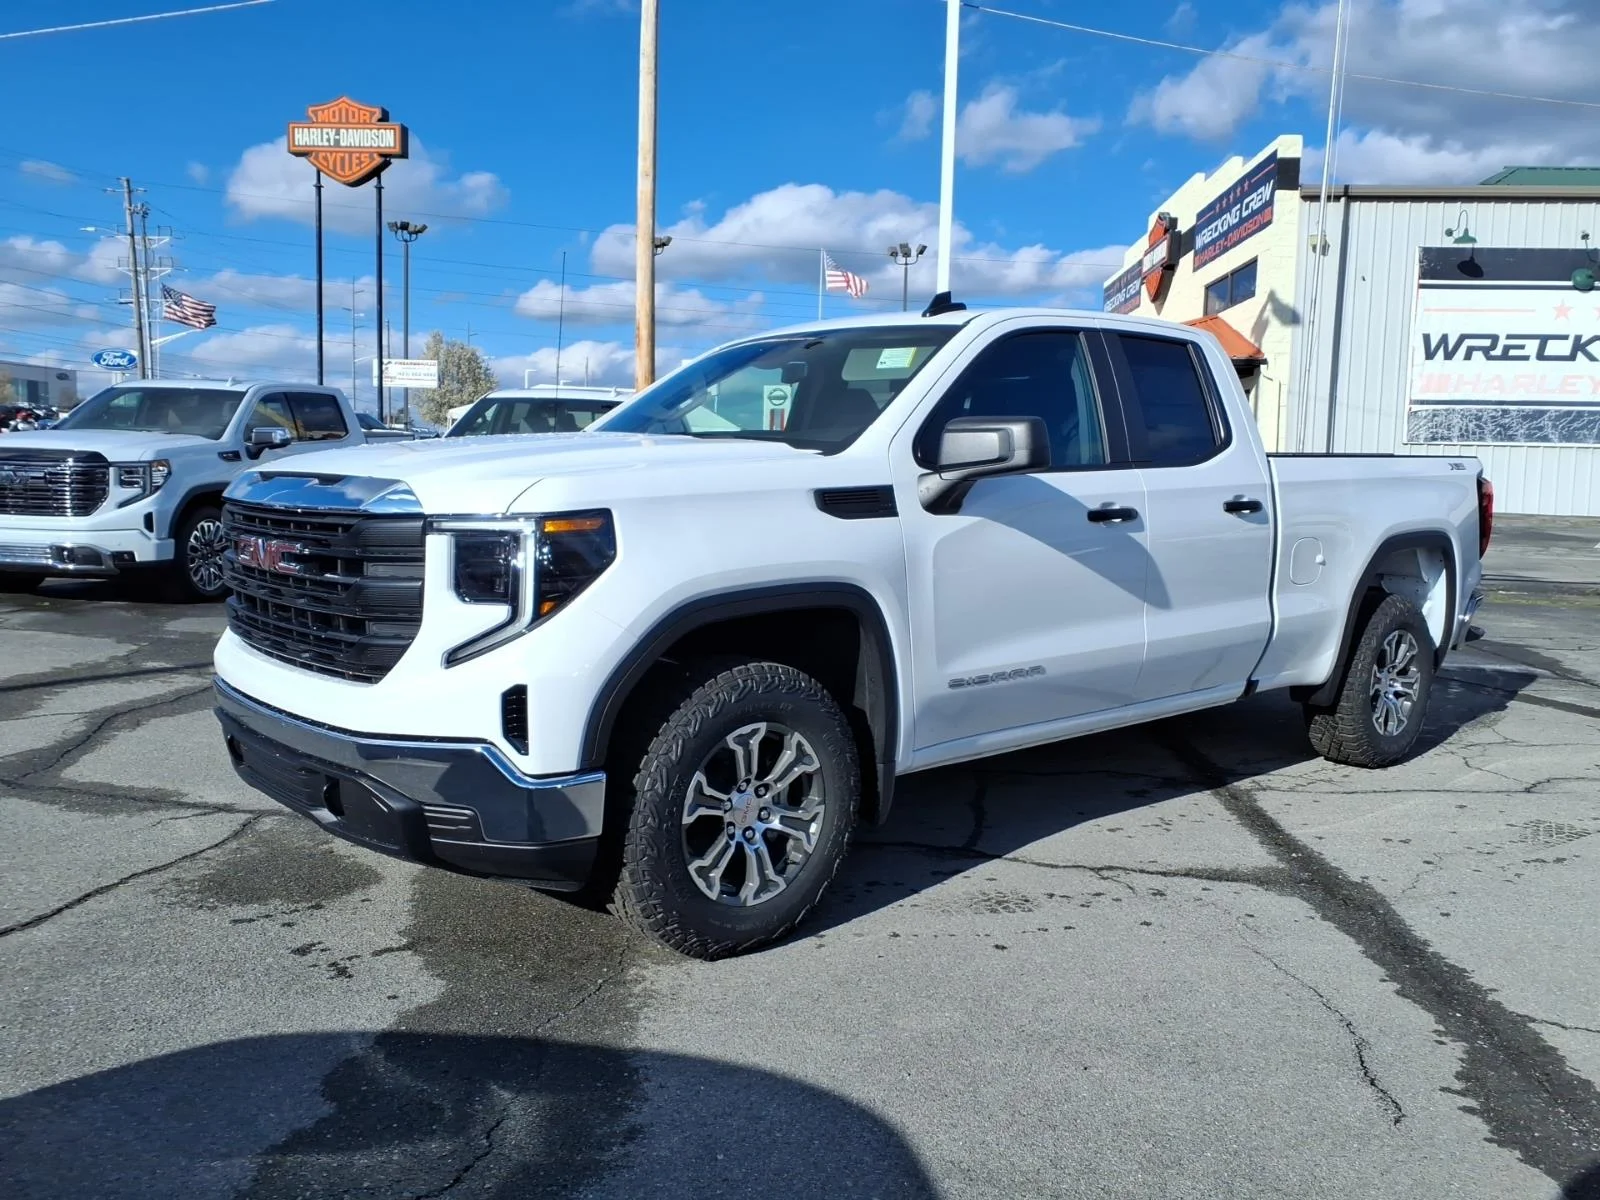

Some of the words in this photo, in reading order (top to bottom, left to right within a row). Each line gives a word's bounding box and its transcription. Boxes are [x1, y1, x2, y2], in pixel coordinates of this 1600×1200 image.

[317, 105, 371, 123] MOTOR
[294, 128, 395, 147] HARLEY-DAVIDSON
[319, 152, 371, 176] CYCLES
[1195, 203, 1241, 250] WRECKING
[1242, 179, 1274, 218] CREW
[1199, 211, 1266, 264] HARLEY-DAVIDSON
[100, 351, 130, 366] Ford
[1422, 333, 1600, 362] WRECK
[234, 535, 303, 575] GMC
